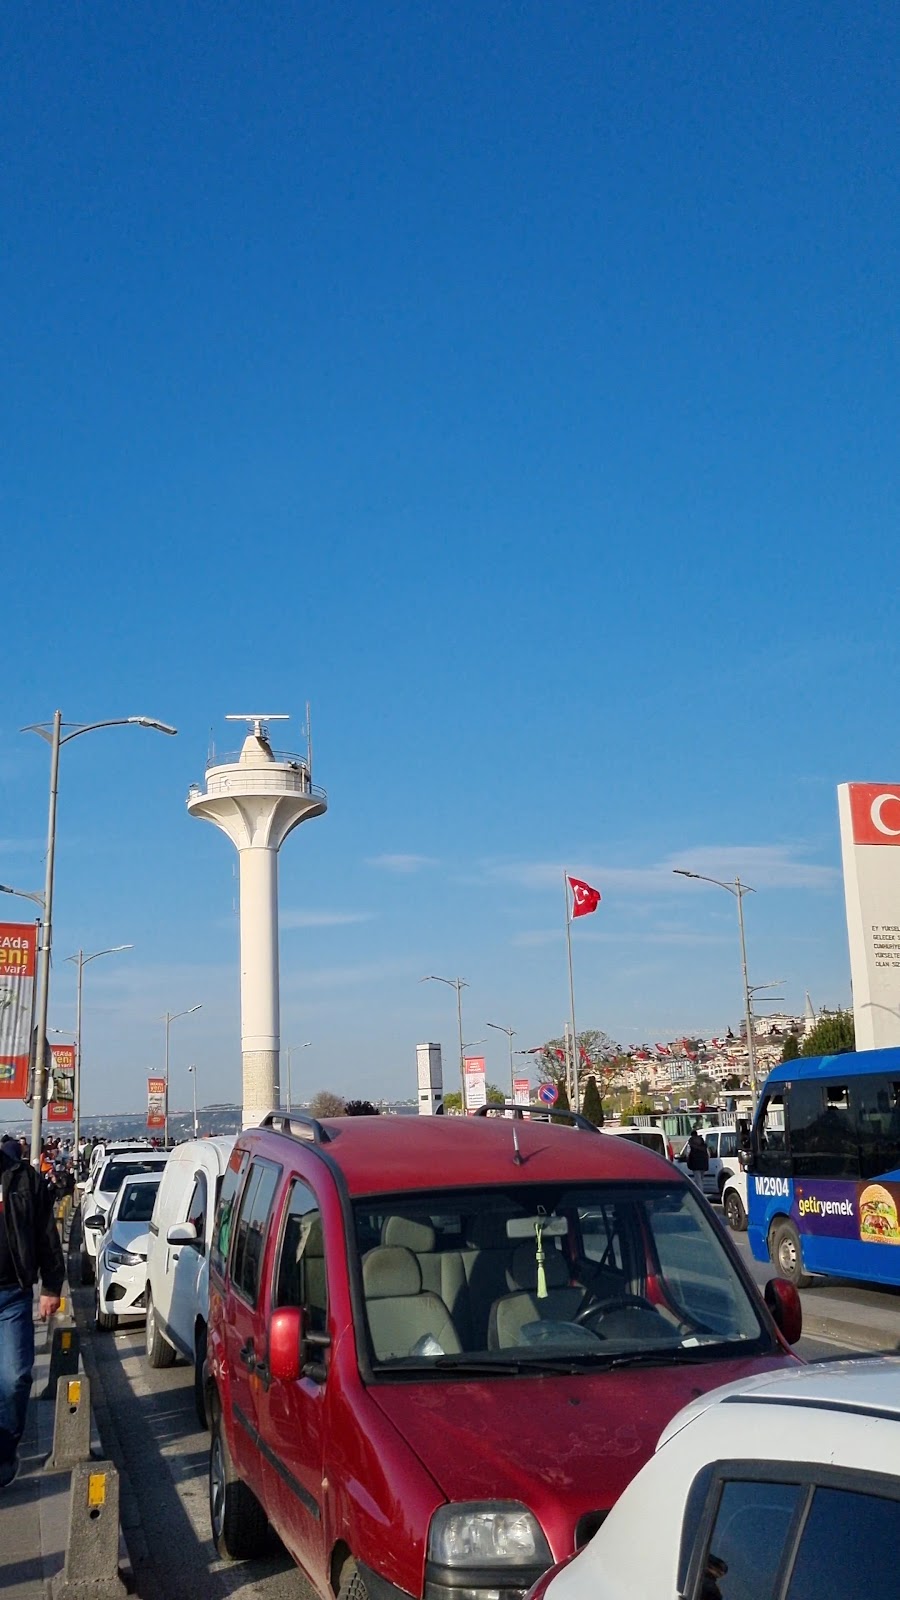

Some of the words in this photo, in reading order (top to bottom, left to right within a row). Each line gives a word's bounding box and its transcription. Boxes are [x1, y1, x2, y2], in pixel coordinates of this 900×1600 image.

[0, 937, 28, 949] A'da
[4, 965, 26, 974] var?
[755, 1176, 789, 1196] M2904
